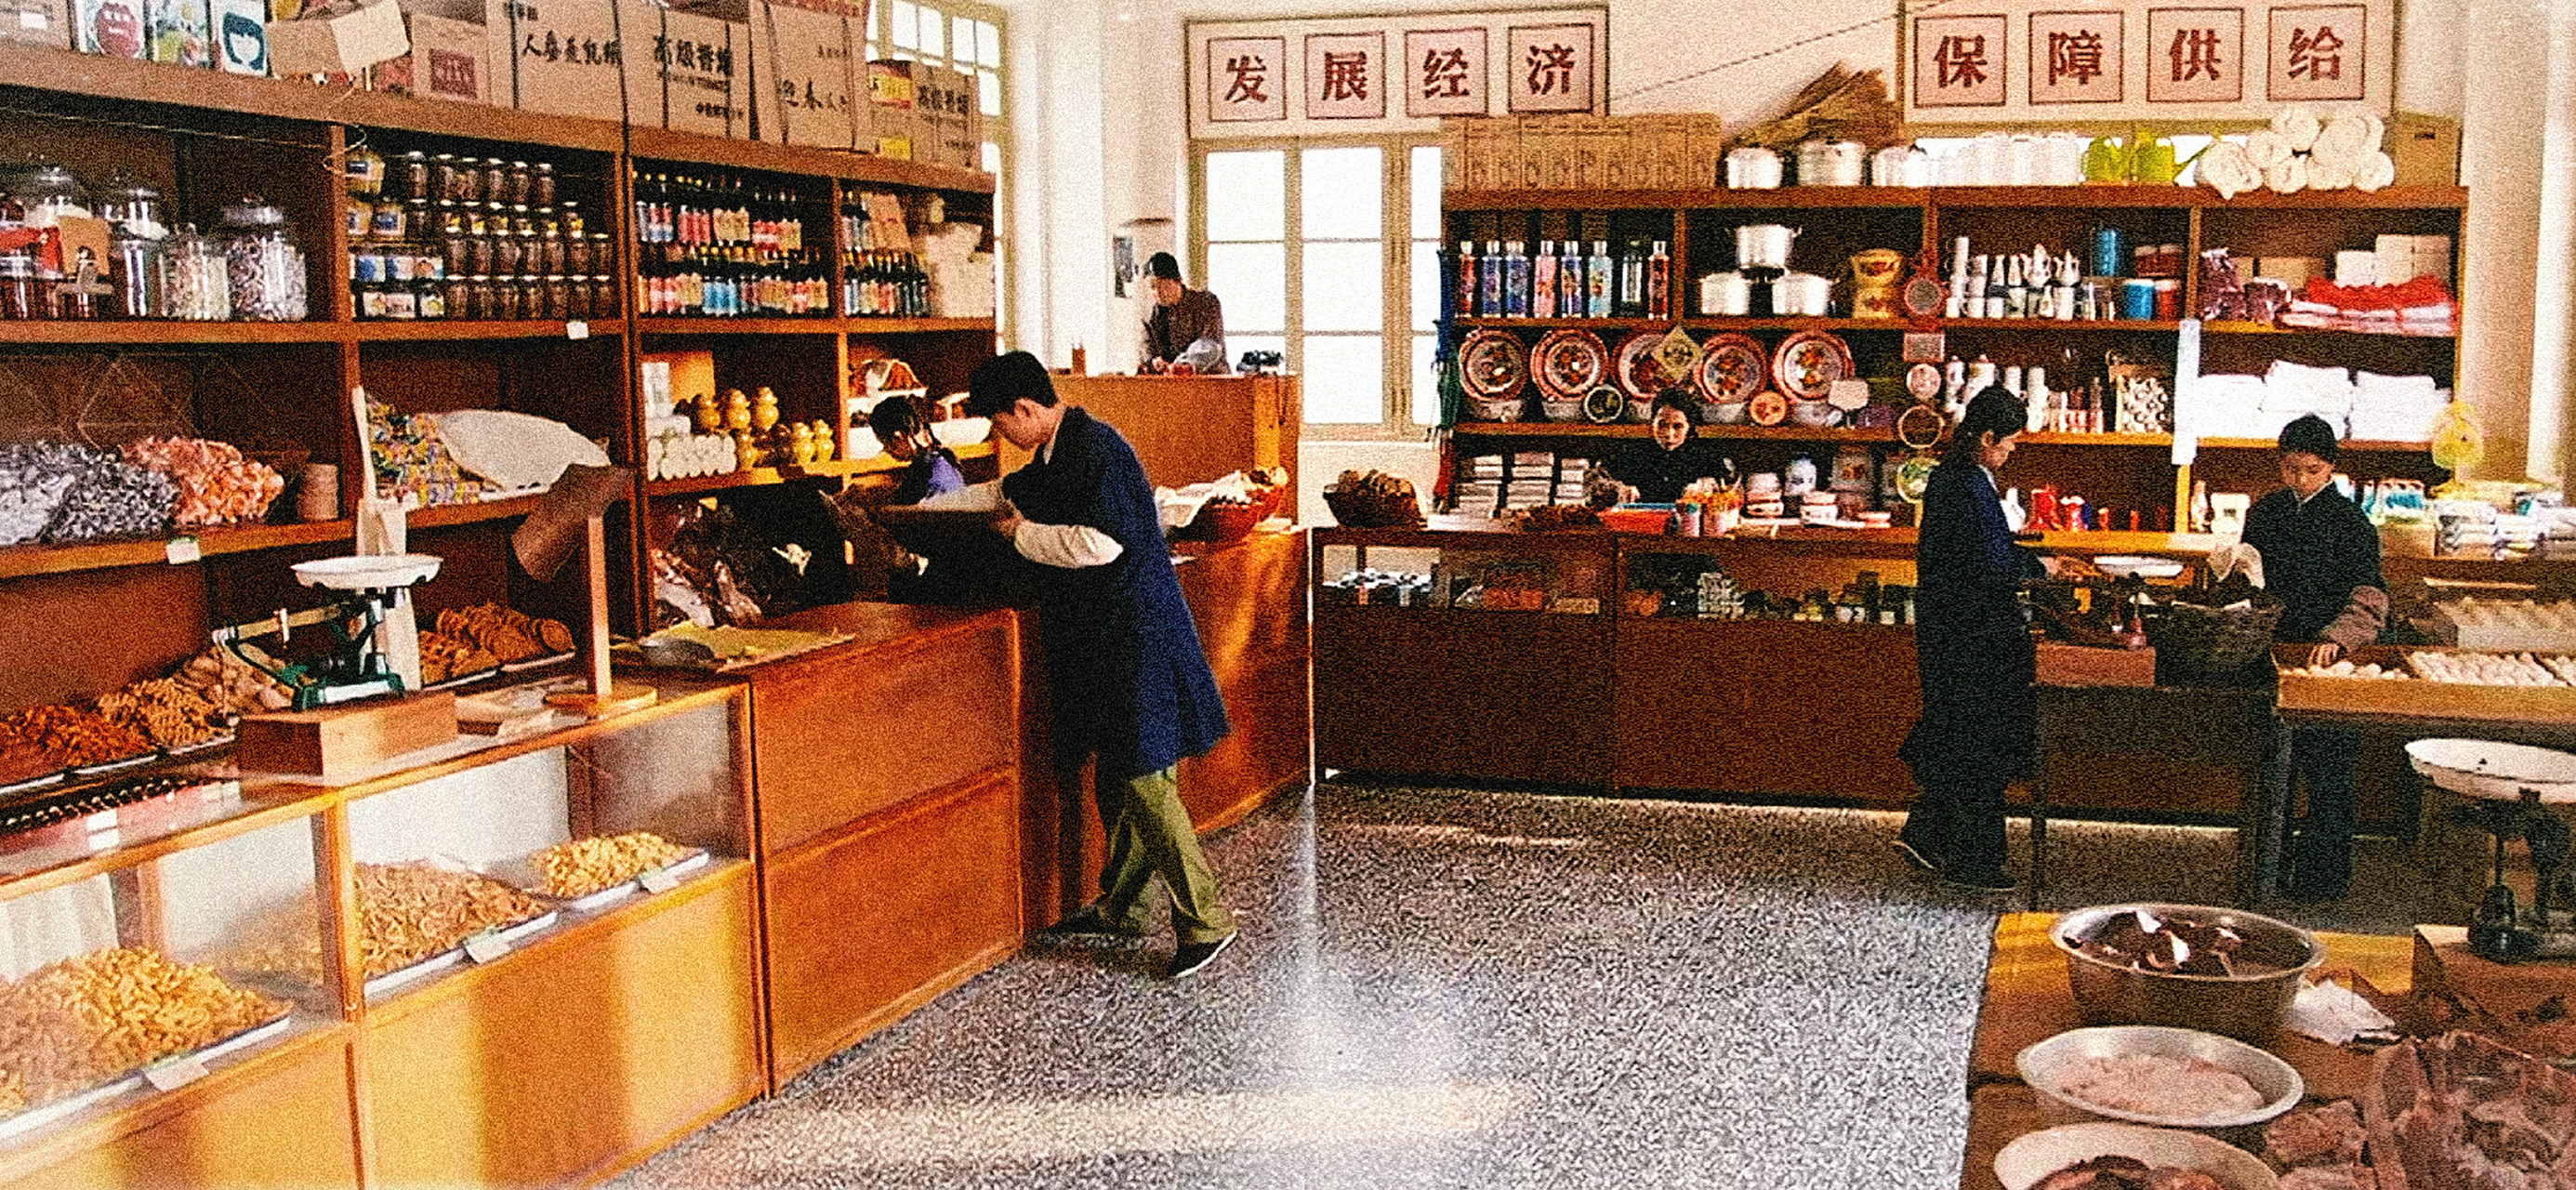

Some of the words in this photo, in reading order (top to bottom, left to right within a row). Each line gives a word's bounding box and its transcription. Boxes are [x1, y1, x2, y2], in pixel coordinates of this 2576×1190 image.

[1224, 44, 1576, 103] 发展经济
[1934, 26, 2344, 89] 保障供给
